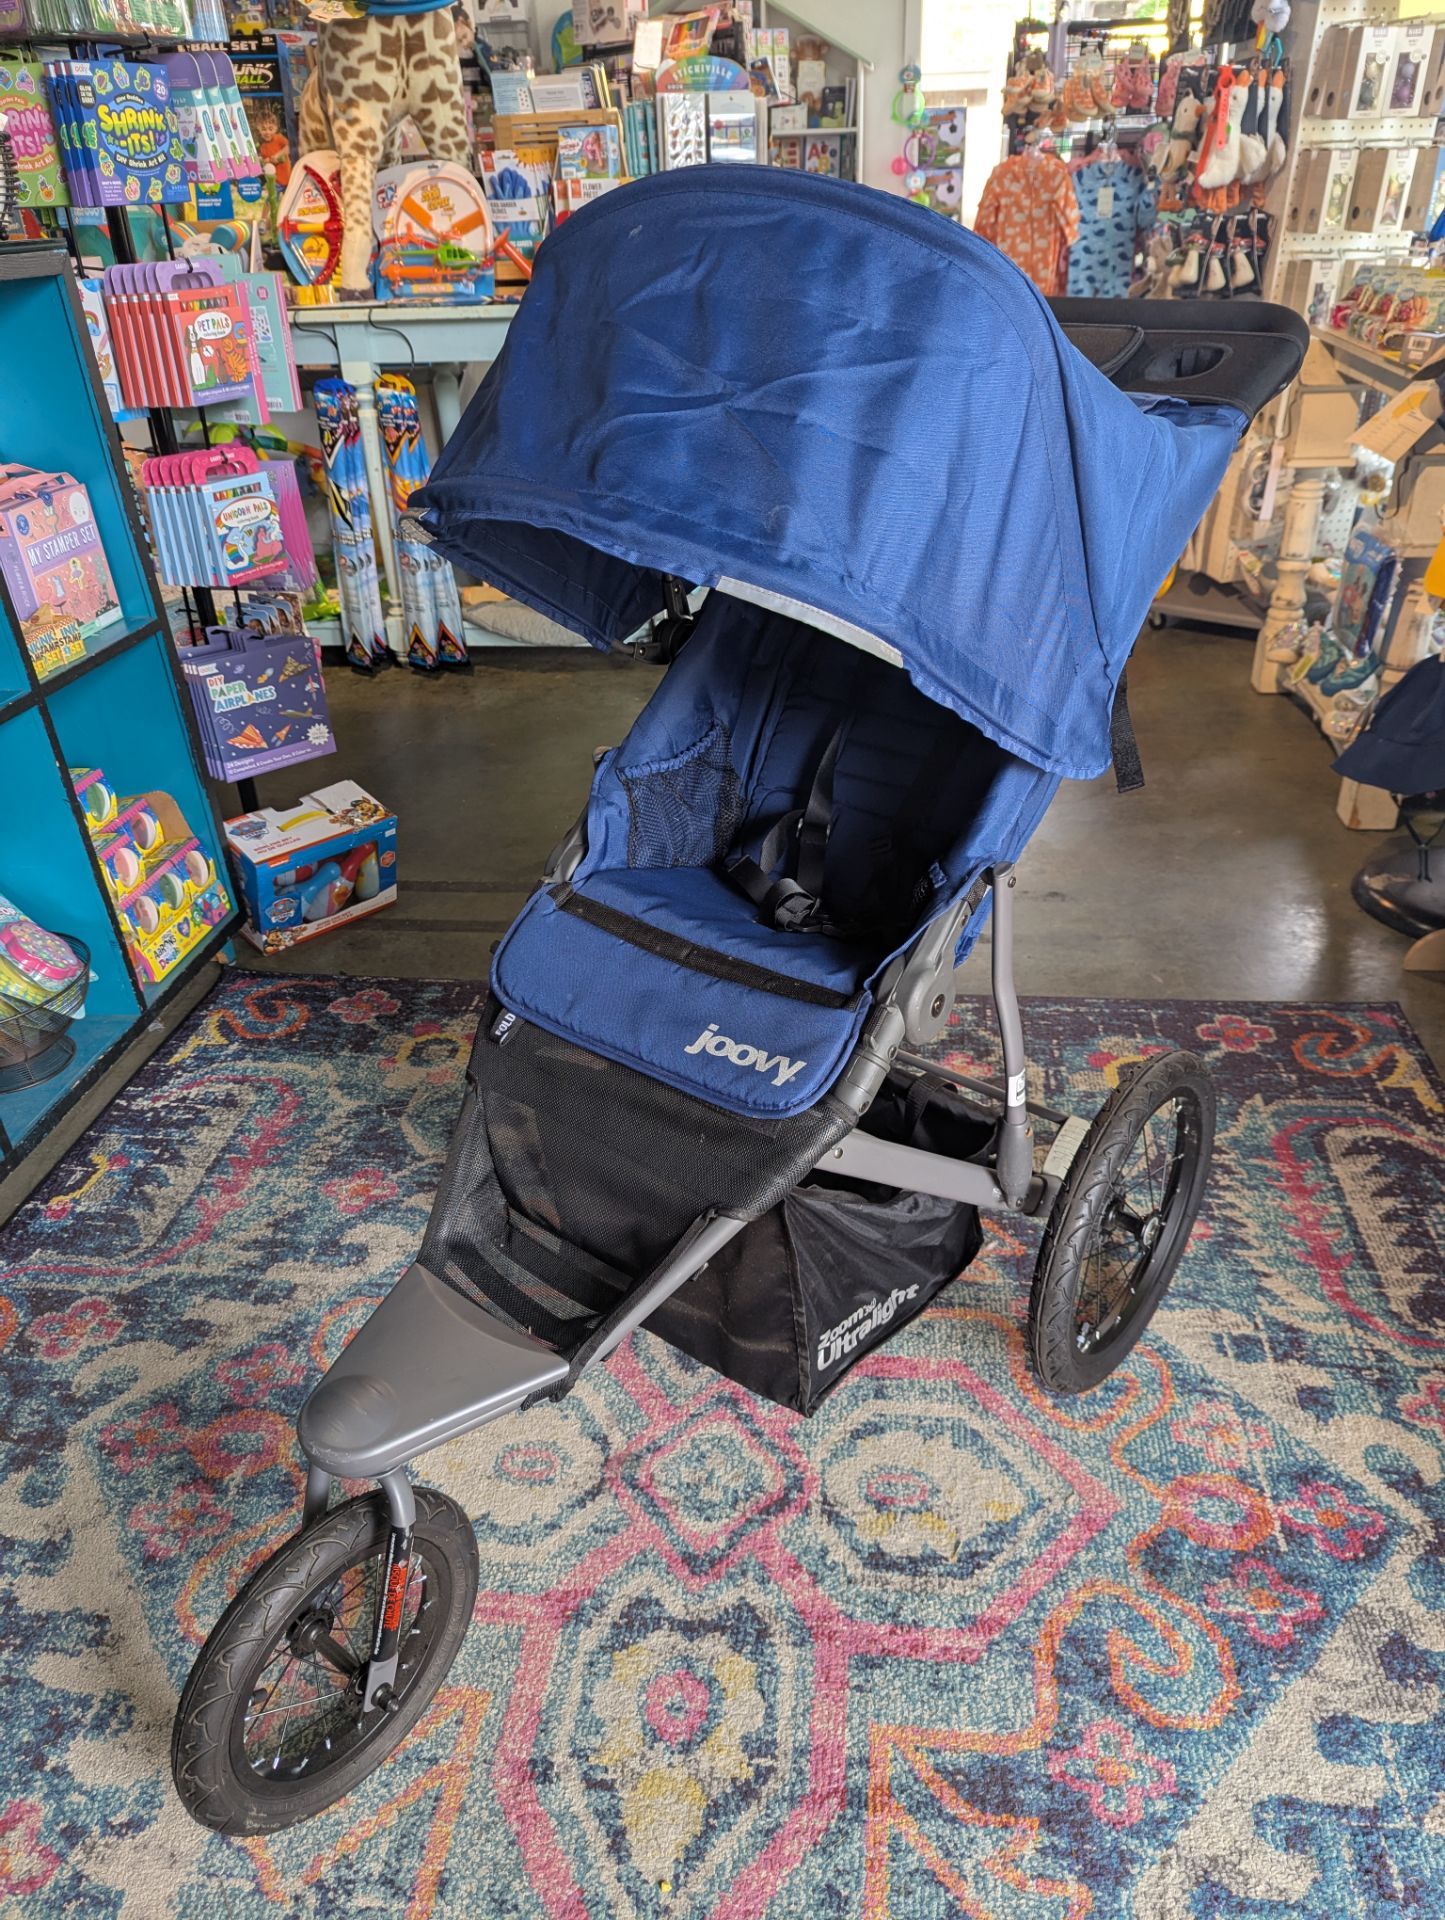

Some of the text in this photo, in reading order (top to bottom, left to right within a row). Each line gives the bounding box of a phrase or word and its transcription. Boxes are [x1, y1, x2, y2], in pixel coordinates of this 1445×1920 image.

[231, 41, 258, 51] SET
[233, 64, 272, 75] UNK
[672, 63, 733, 81] STICKIVILLE
[157, 84, 167, 94] 20
[98, 104, 167, 137] SHRINK
[16, 161, 33, 169] hrink
[197, 317, 230, 332] PET PALS
[223, 502, 269, 521] UNICORN PALS
[27, 524, 96, 567] MY STAMPER SET
[208, 676, 224, 687] DIY
[212, 683, 246, 699] PAPER
[494, 1012, 516, 1036] FOLD
[684, 1023, 807, 1086] joovy
[818, 1283, 920, 1371] Ultralight
[389, 1563, 401, 1591] RISQUE
[383, 1601, 395, 1629] CHUTE
